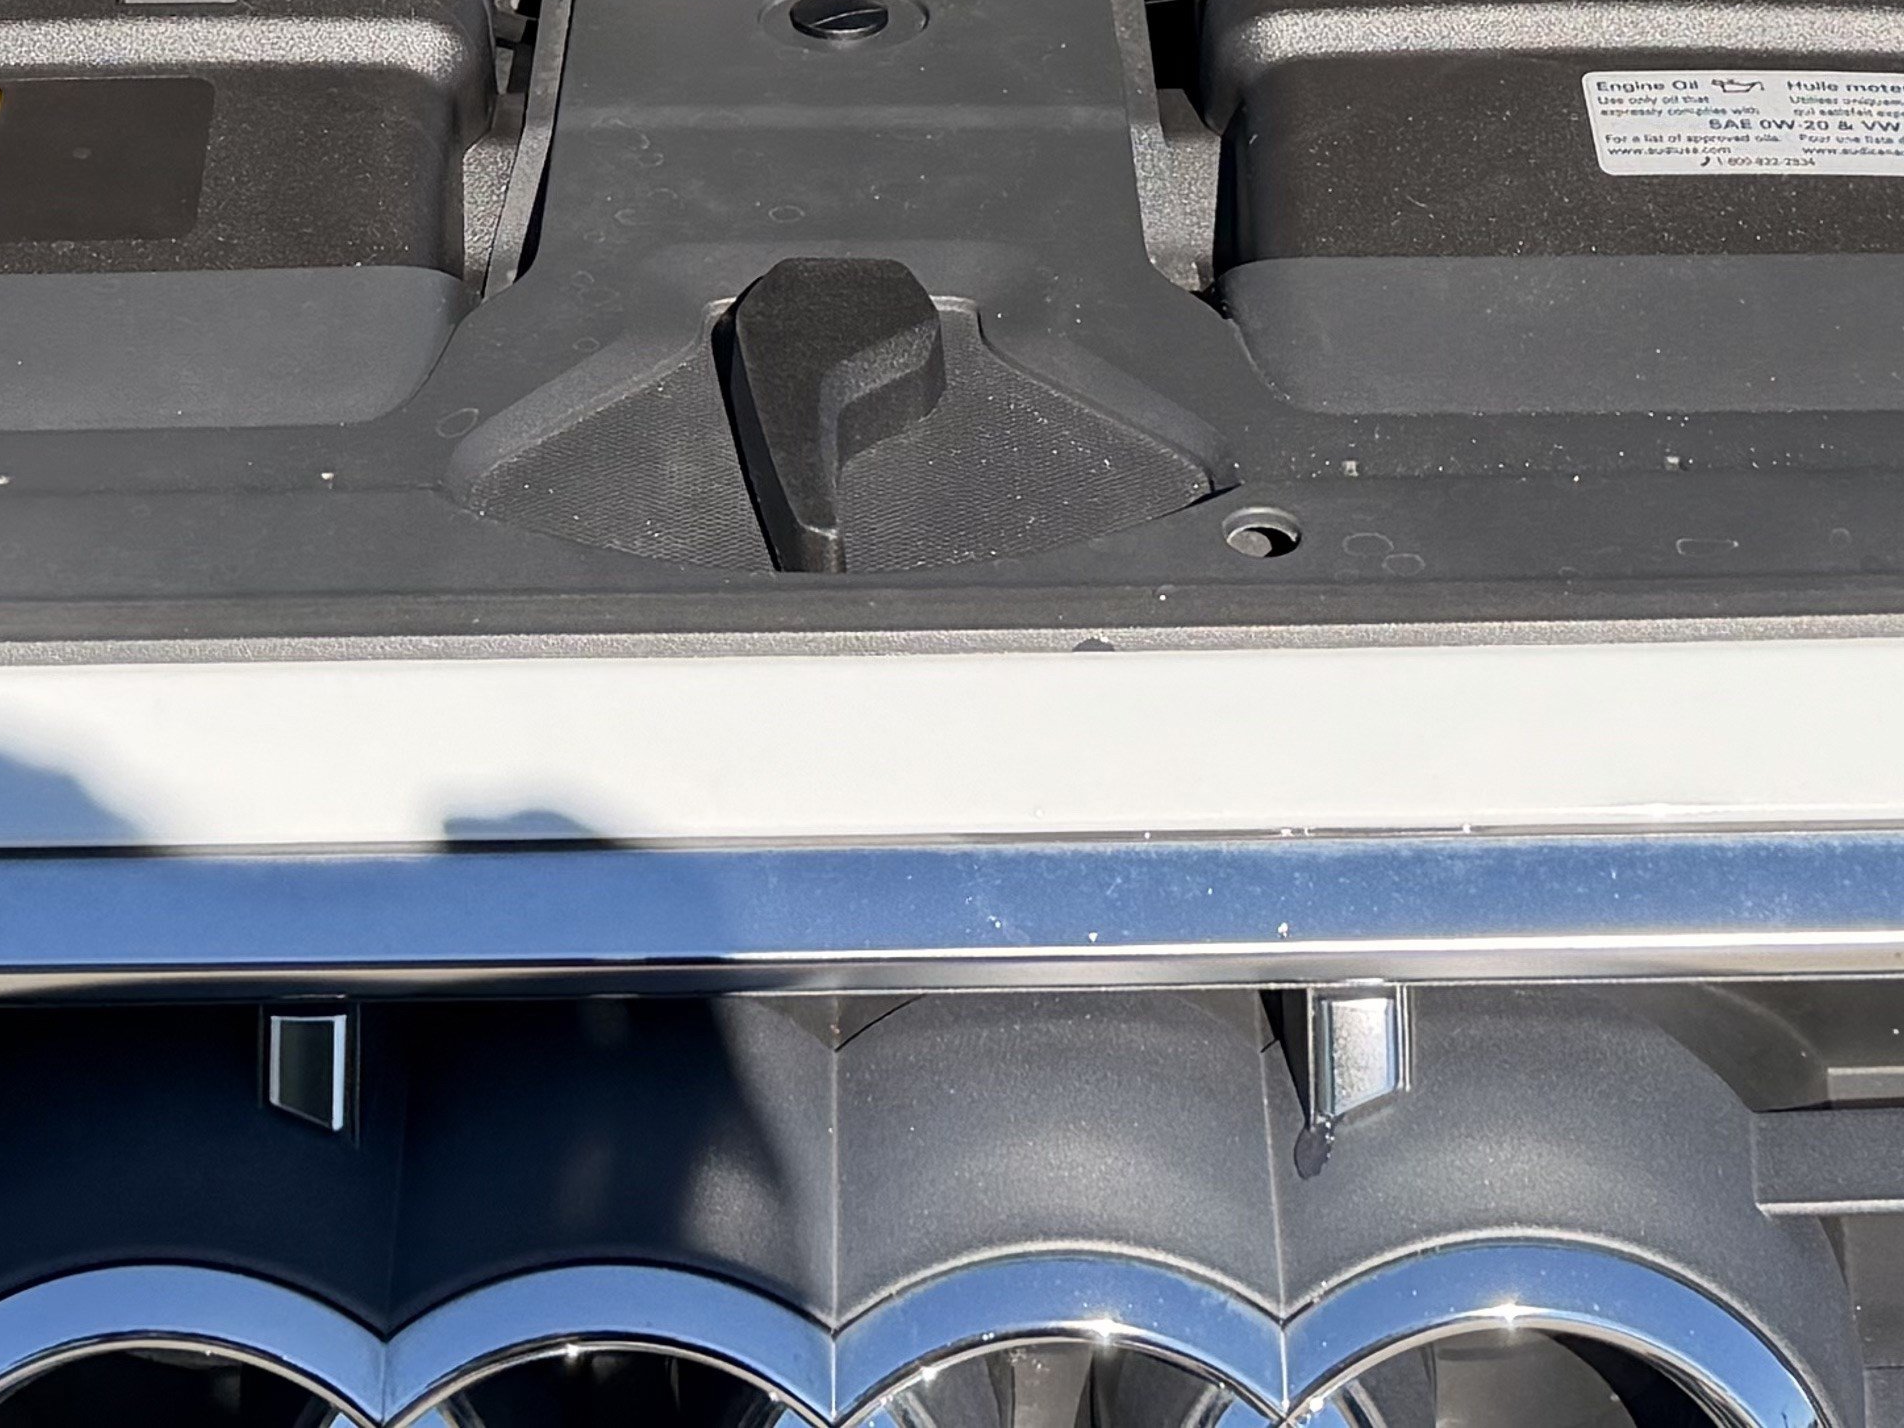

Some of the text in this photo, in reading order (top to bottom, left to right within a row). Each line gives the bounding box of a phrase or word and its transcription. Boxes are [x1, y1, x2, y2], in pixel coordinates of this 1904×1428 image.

[1596, 80, 1699, 93] Engine Oil
[1786, 80, 1838, 92] Huile
[1709, 118, 1753, 130] SAE
[1838, 120, 1854, 131] &
[1861, 120, 1900, 132] VW
